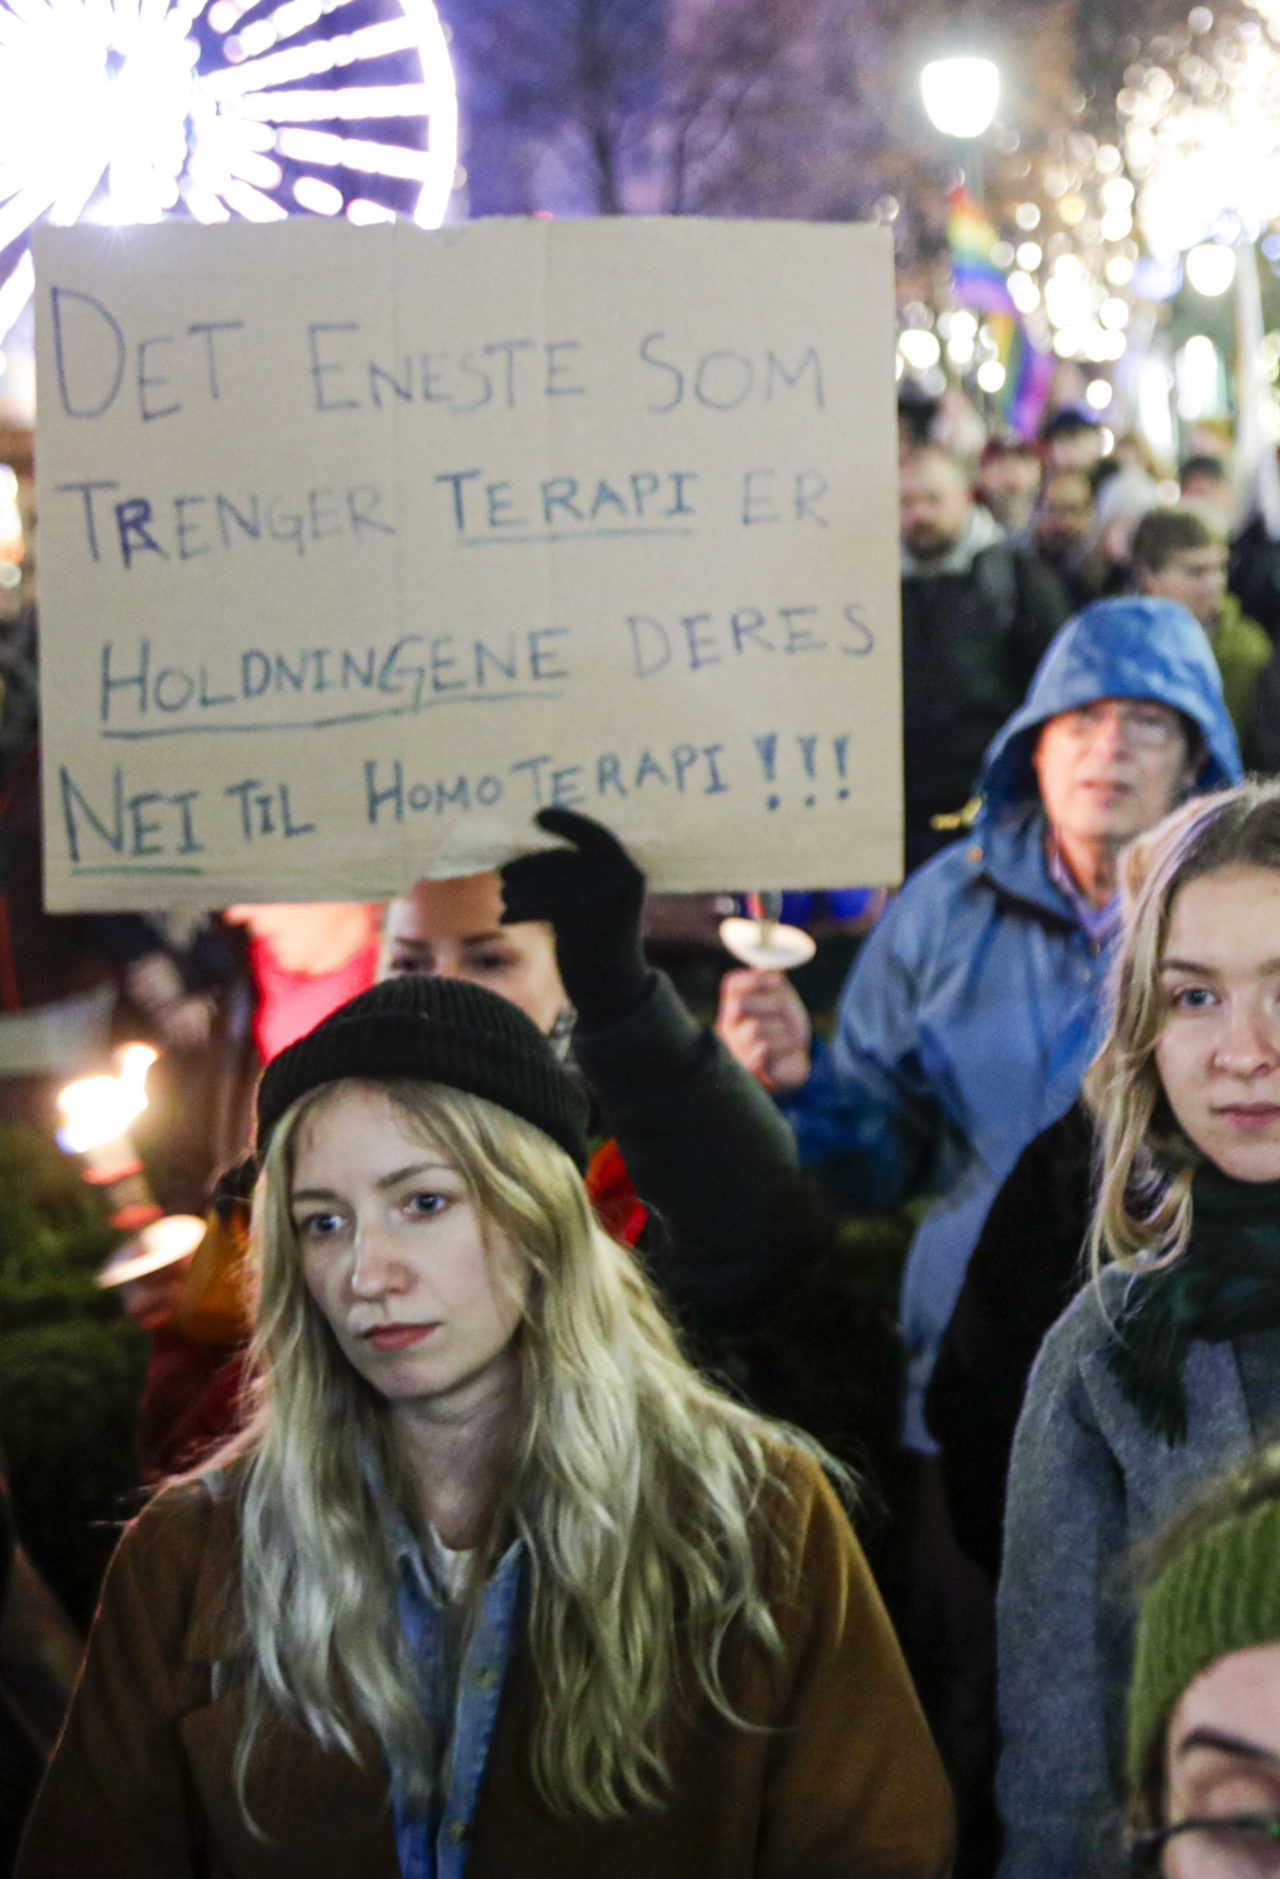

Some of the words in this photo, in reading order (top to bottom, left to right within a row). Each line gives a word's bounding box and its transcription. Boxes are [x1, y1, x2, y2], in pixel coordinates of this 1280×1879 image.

[52, 286, 244, 421] DET
[308, 323, 586, 412] ENESTE
[640, 332, 825, 414] SOM
[56, 482, 396, 568] TRENGER
[435, 470, 699, 528] TERAPI
[742, 470, 830, 527] ER
[100, 627, 571, 721] HOLDNINGENE
[628, 604, 875, 678] DERES
[60, 765, 202, 861] NEI
[226, 781, 315, 840] TIL
